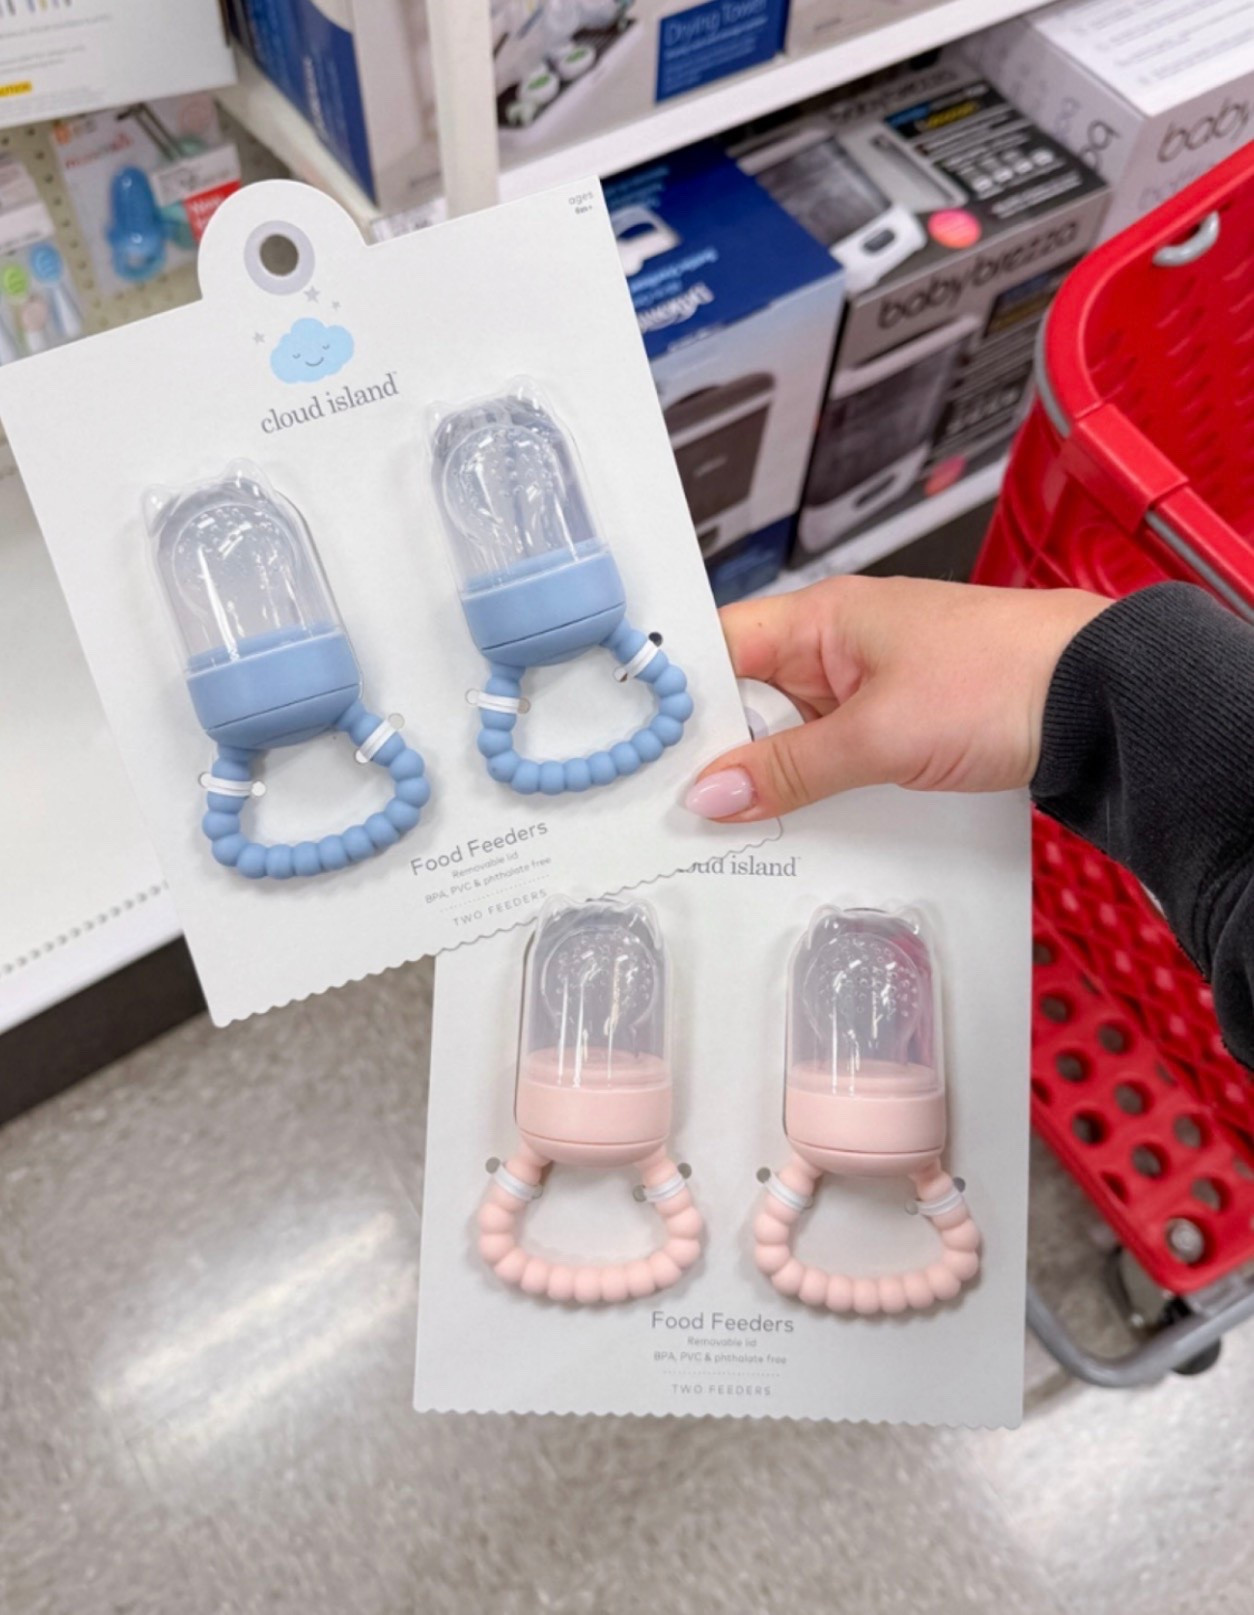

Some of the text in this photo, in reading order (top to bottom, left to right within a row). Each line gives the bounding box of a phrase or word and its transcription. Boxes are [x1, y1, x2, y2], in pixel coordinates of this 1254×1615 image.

[1157, 97, 1250, 164] baby
[568, 192, 593, 205] ages
[261, 373, 399, 434] cloud island
[411, 822, 548, 876] Food Feeders
[450, 882, 472, 895] PVC
[473, 878, 482, 888] &
[483, 864, 530, 886] phthalate
[531, 856, 552, 869] free
[451, 851, 519, 879] Removable lid
[731, 855, 797, 876] island
[453, 889, 548, 926] TWO FEEDERS
[651, 1311, 794, 1333] Food Feeders
[687, 1336, 757, 1347] Removable lid
[680, 1351, 701, 1362] PVC
[704, 1352, 712, 1362] &
[714, 1352, 764, 1363] phthalate
[767, 1354, 787, 1365] free
[672, 1384, 771, 1396] TWO FEEDERS
